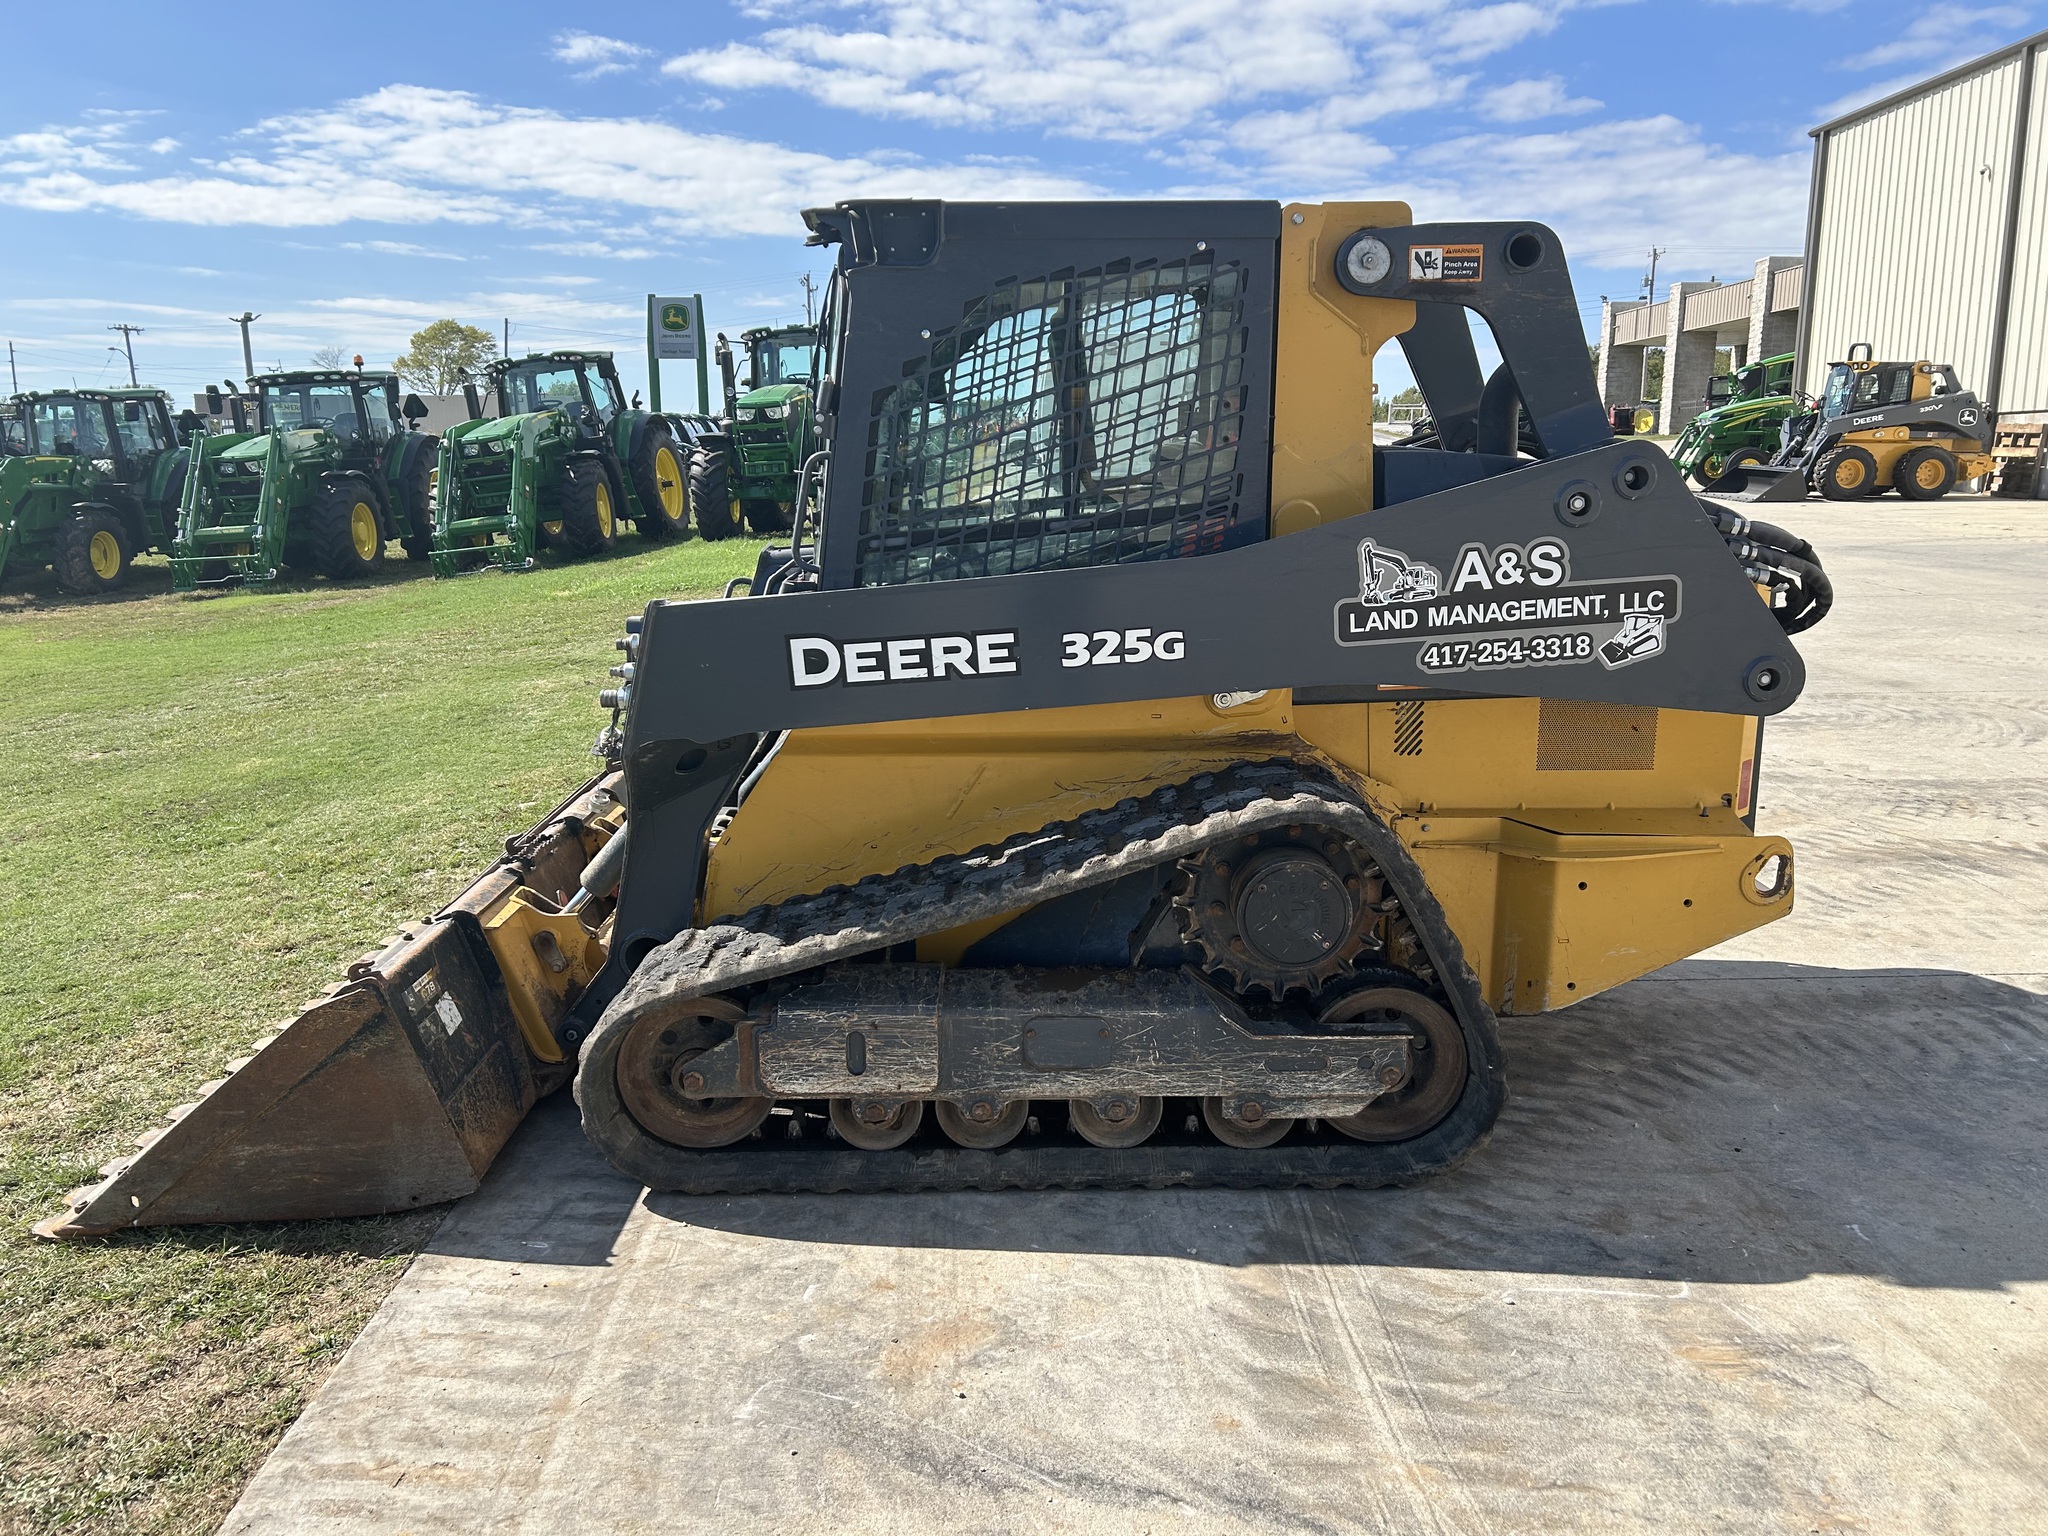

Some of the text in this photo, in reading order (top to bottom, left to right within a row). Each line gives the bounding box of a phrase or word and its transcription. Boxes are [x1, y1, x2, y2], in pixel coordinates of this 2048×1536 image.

[1853, 414, 1885, 426] DEERE
[1453, 543, 1564, 593] A&S
[1348, 590, 1666, 634] LAND MANAGEMENT, LLC
[789, 628, 1186, 688] DEERE 325G
[1423, 635, 1592, 668] 417-254-3318
